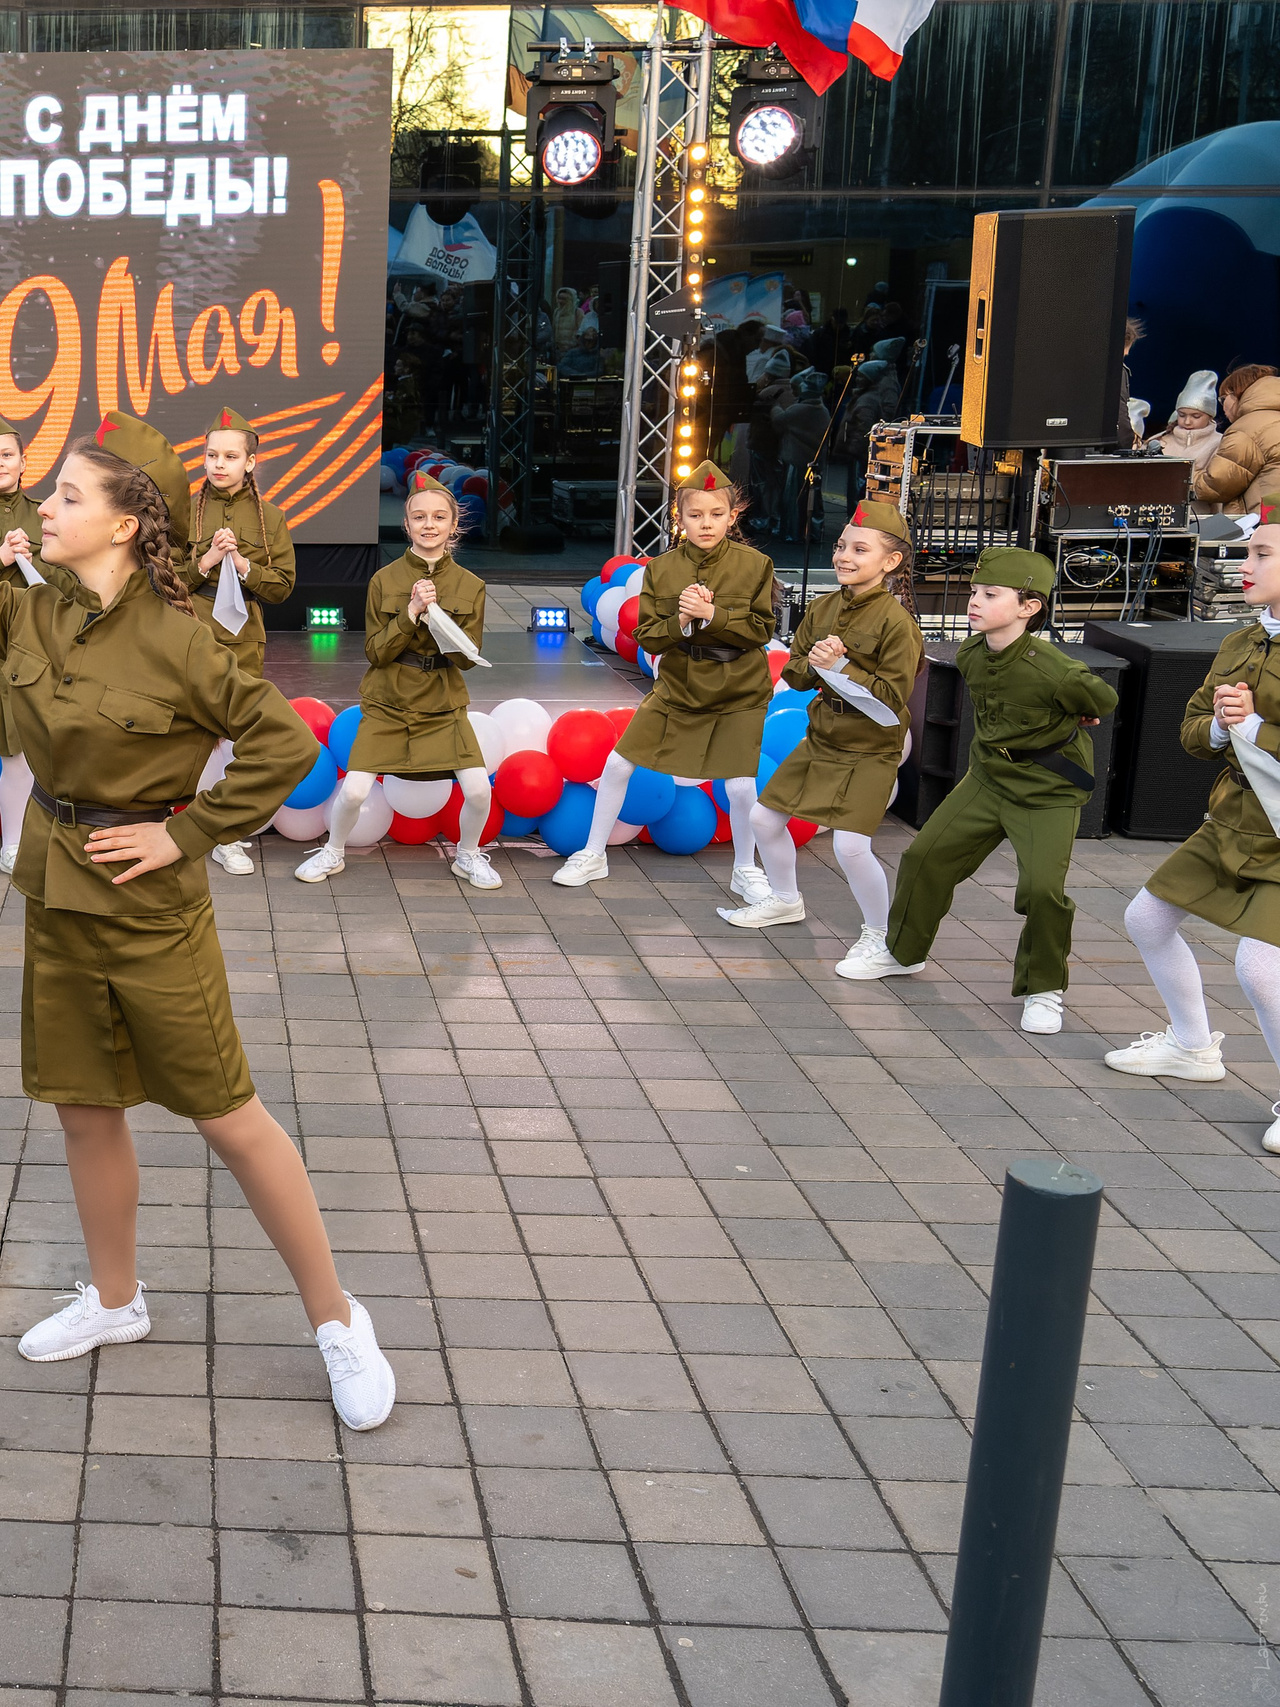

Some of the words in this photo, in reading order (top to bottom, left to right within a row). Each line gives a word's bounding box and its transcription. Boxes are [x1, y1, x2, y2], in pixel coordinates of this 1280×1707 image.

[24, 95, 64, 144] С
[78, 84, 247, 152] ДНЁМ
[0, 156, 289, 227] ПОБЕДЫ!
[429, 246, 469, 269] ДОБРО
